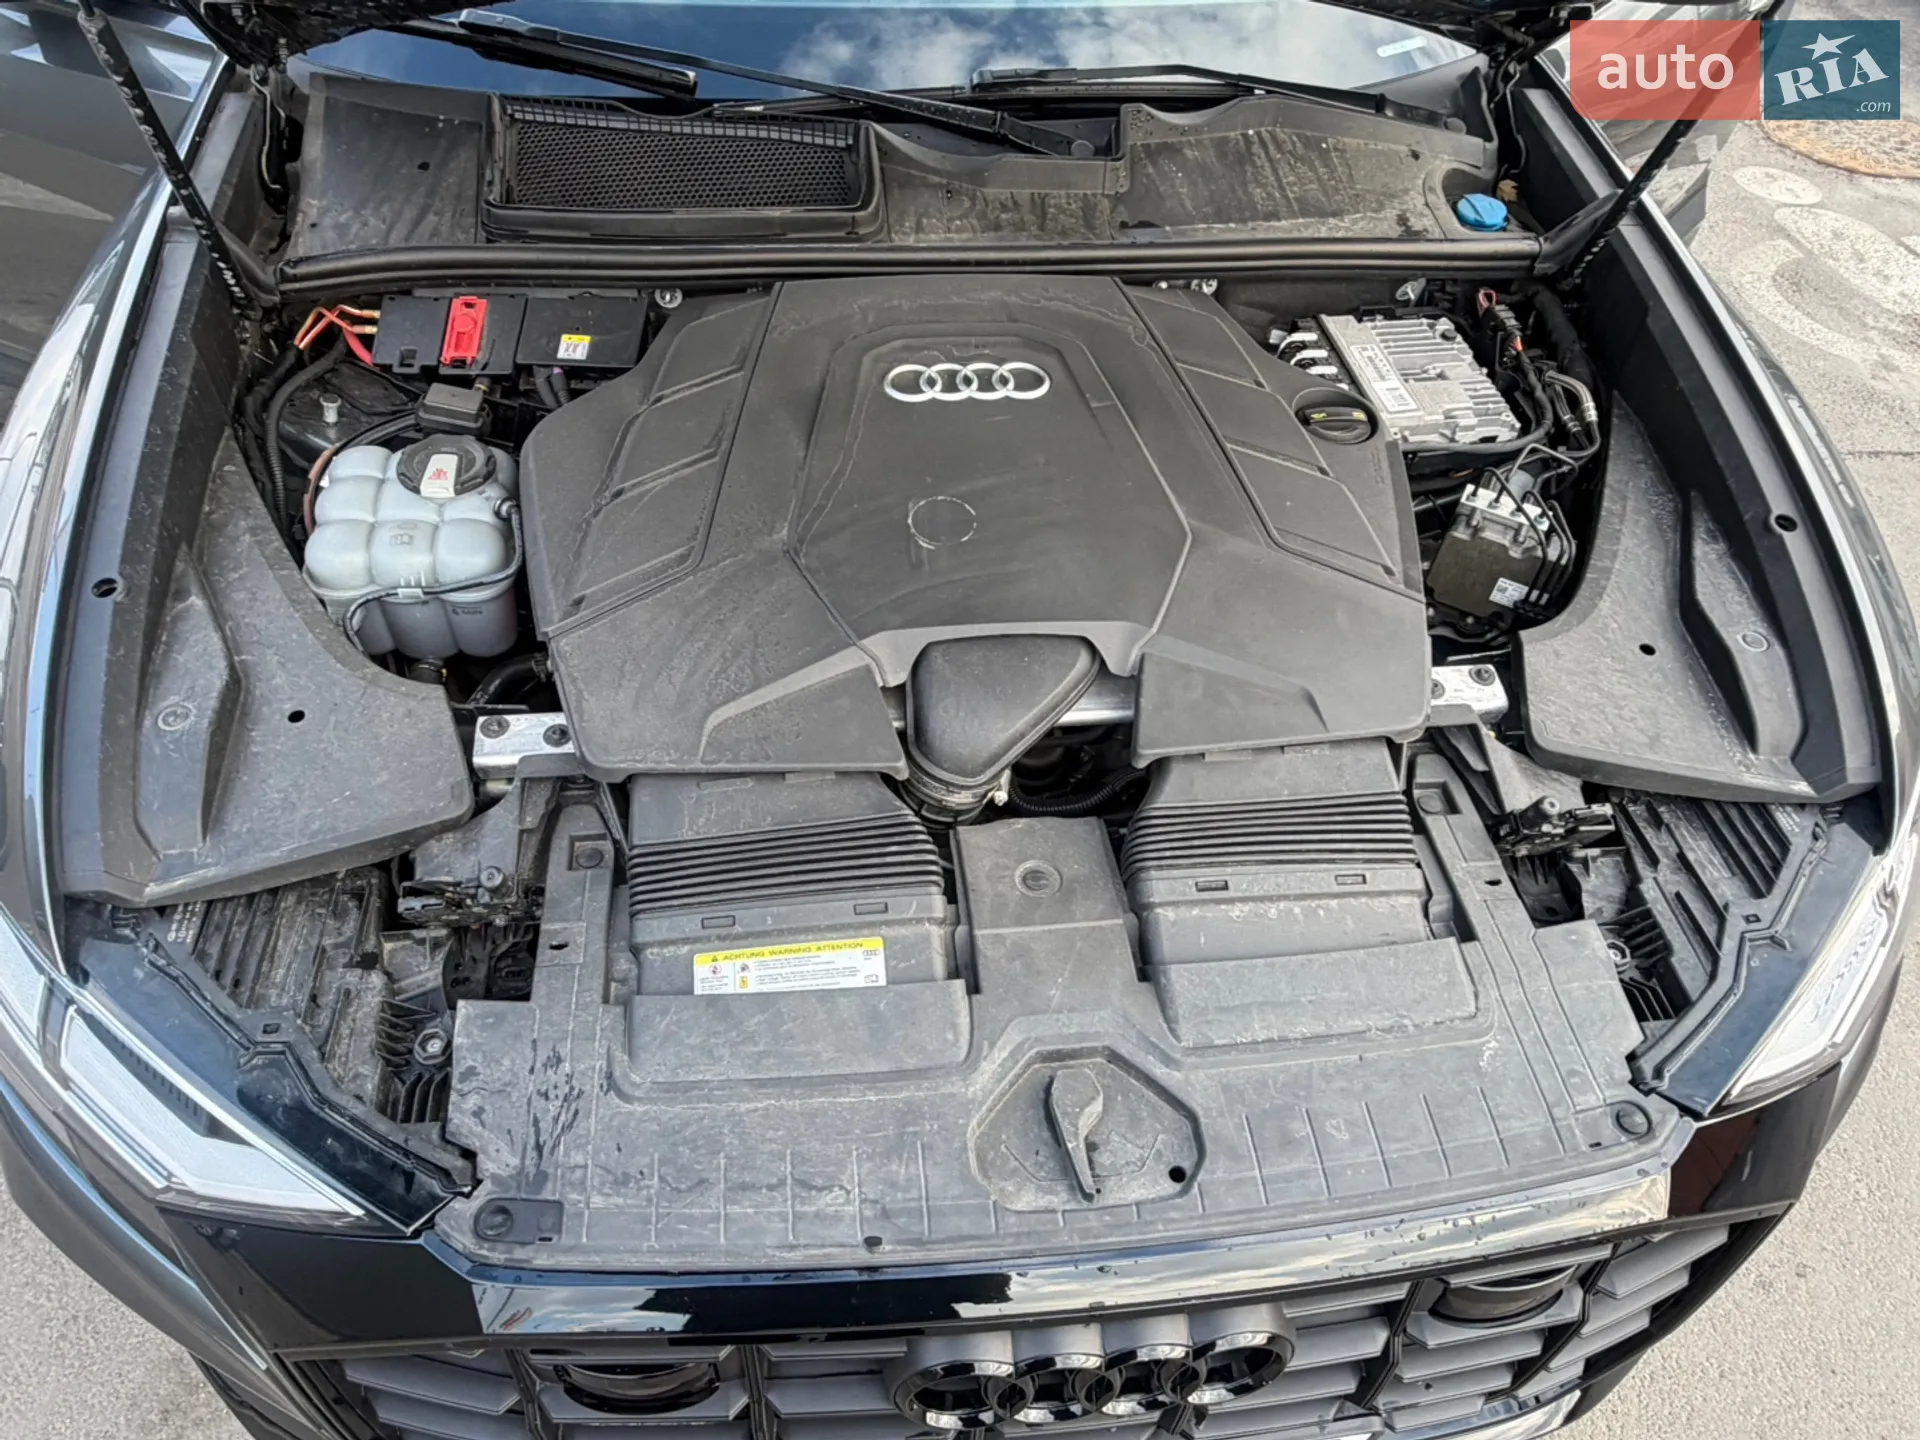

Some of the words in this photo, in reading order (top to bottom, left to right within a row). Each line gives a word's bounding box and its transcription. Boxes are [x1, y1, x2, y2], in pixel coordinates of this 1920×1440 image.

[723, 952, 765, 961] ACHTUNG
[769, 946, 811, 956] WARNING
[815, 942, 863, 952] ATTENTION
